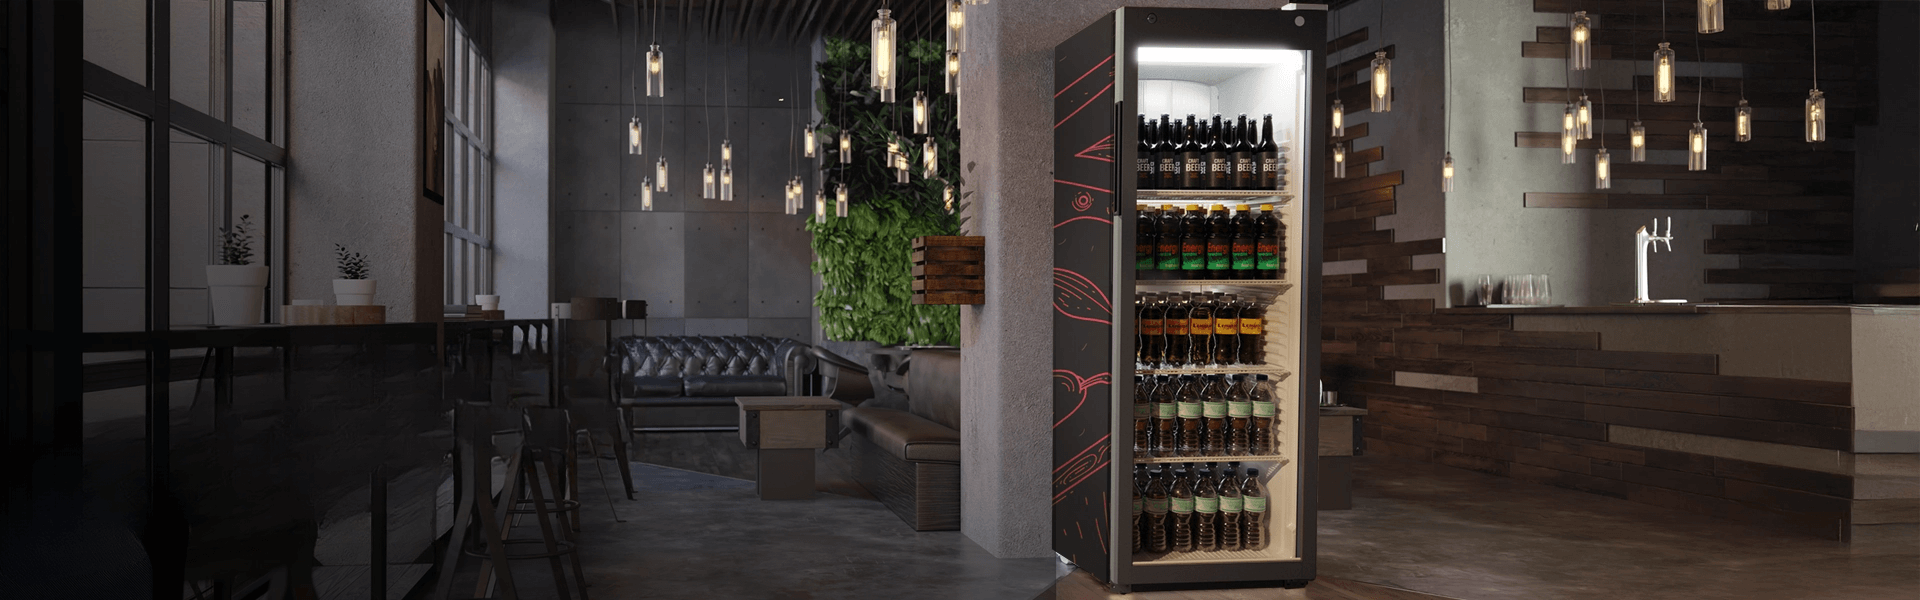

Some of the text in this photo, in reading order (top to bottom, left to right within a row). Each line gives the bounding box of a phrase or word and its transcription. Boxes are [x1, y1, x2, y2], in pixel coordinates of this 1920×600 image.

[1182, 242, 1205, 255] Energ
[1207, 242, 1229, 255] Energ
[1232, 242, 1254, 255] Energ
[1257, 242, 1278, 255] Energ
